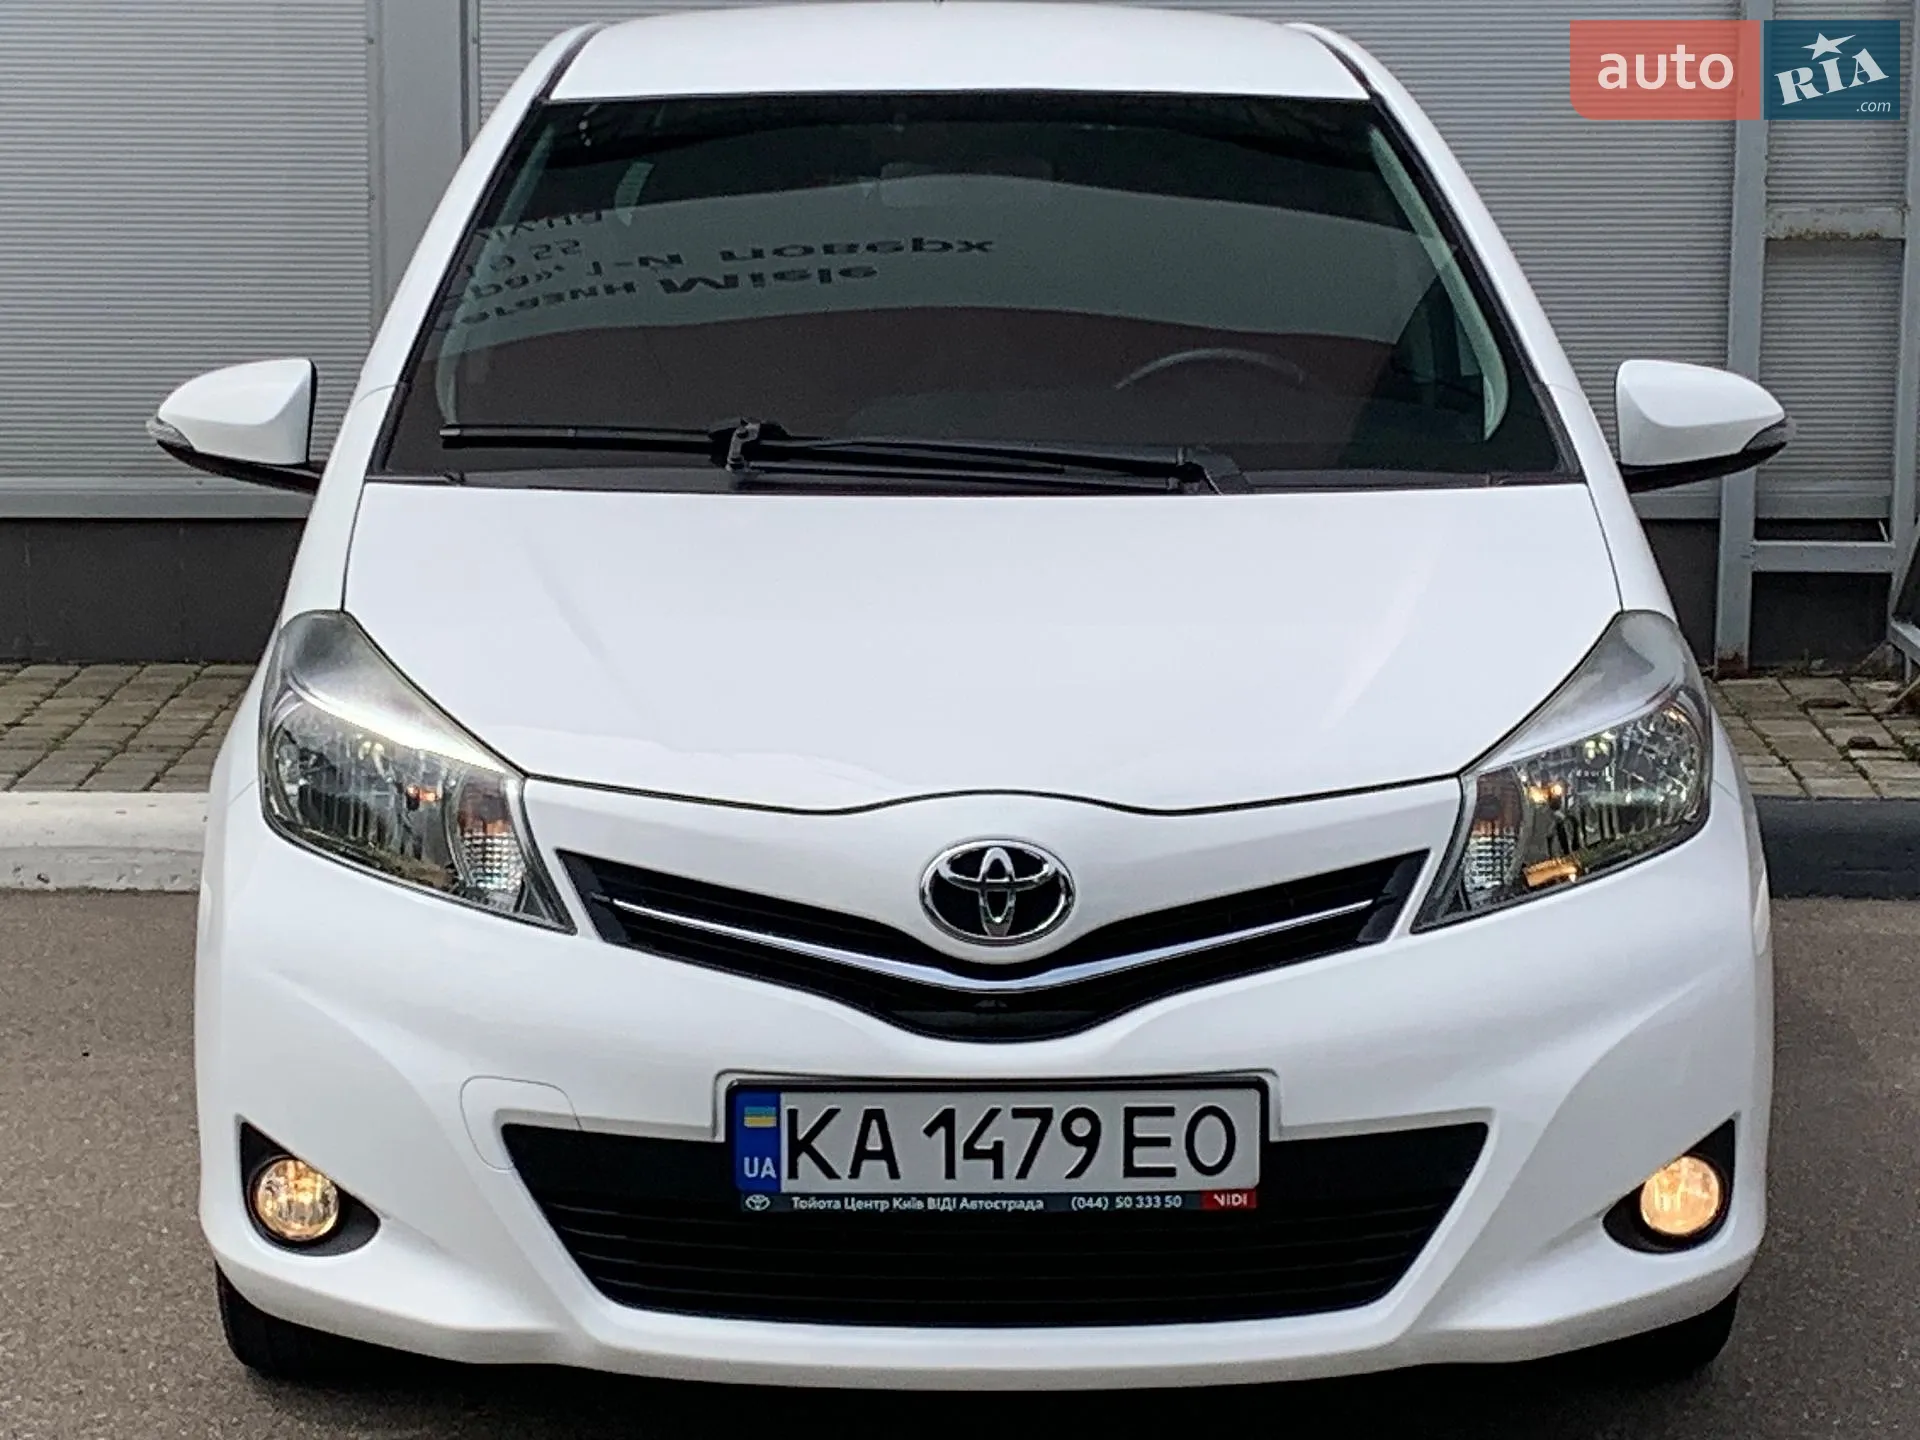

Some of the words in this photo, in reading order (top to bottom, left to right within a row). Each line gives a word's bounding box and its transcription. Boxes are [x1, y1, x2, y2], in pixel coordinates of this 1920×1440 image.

[786, 1107, 901, 1181] KA
[922, 1106, 1102, 1181] 1479
[1122, 1104, 1237, 1178] EO
[743, 1156, 777, 1179] UA
[792, 1196, 842, 1211] Тойота
[844, 1196, 890, 1213] Центр
[892, 1196, 925, 1211] Київ
[960, 1196, 1044, 1212] Автострада
[1071, 1195, 1110, 1210] (044)
